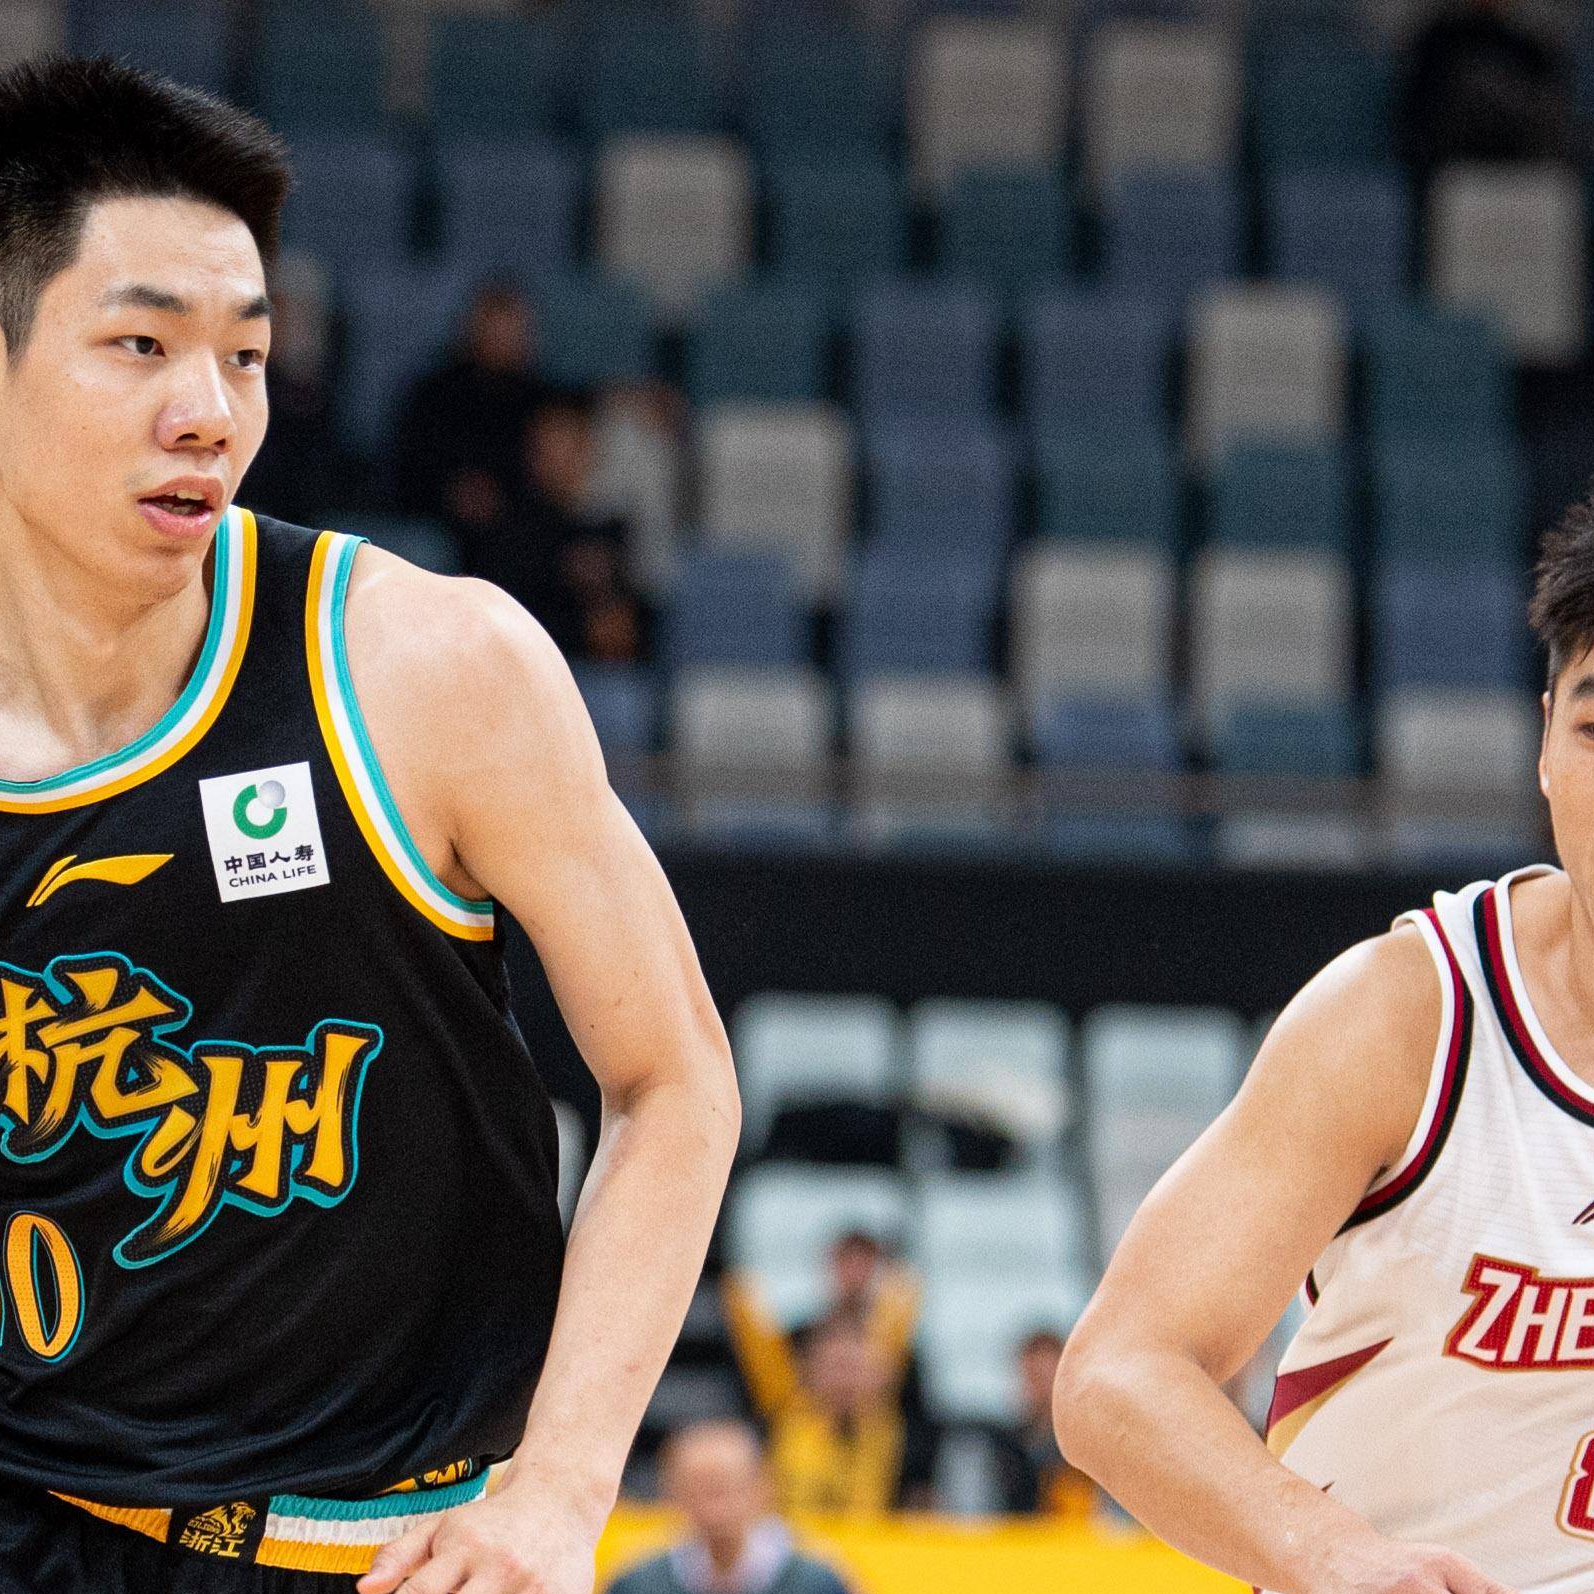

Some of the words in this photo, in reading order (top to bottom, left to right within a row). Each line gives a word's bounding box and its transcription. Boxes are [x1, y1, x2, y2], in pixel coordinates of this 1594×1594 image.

[224, 844, 314, 875] 中国人寿
[228, 872, 278, 888] CHINA
[282, 864, 317, 880] LIFE
